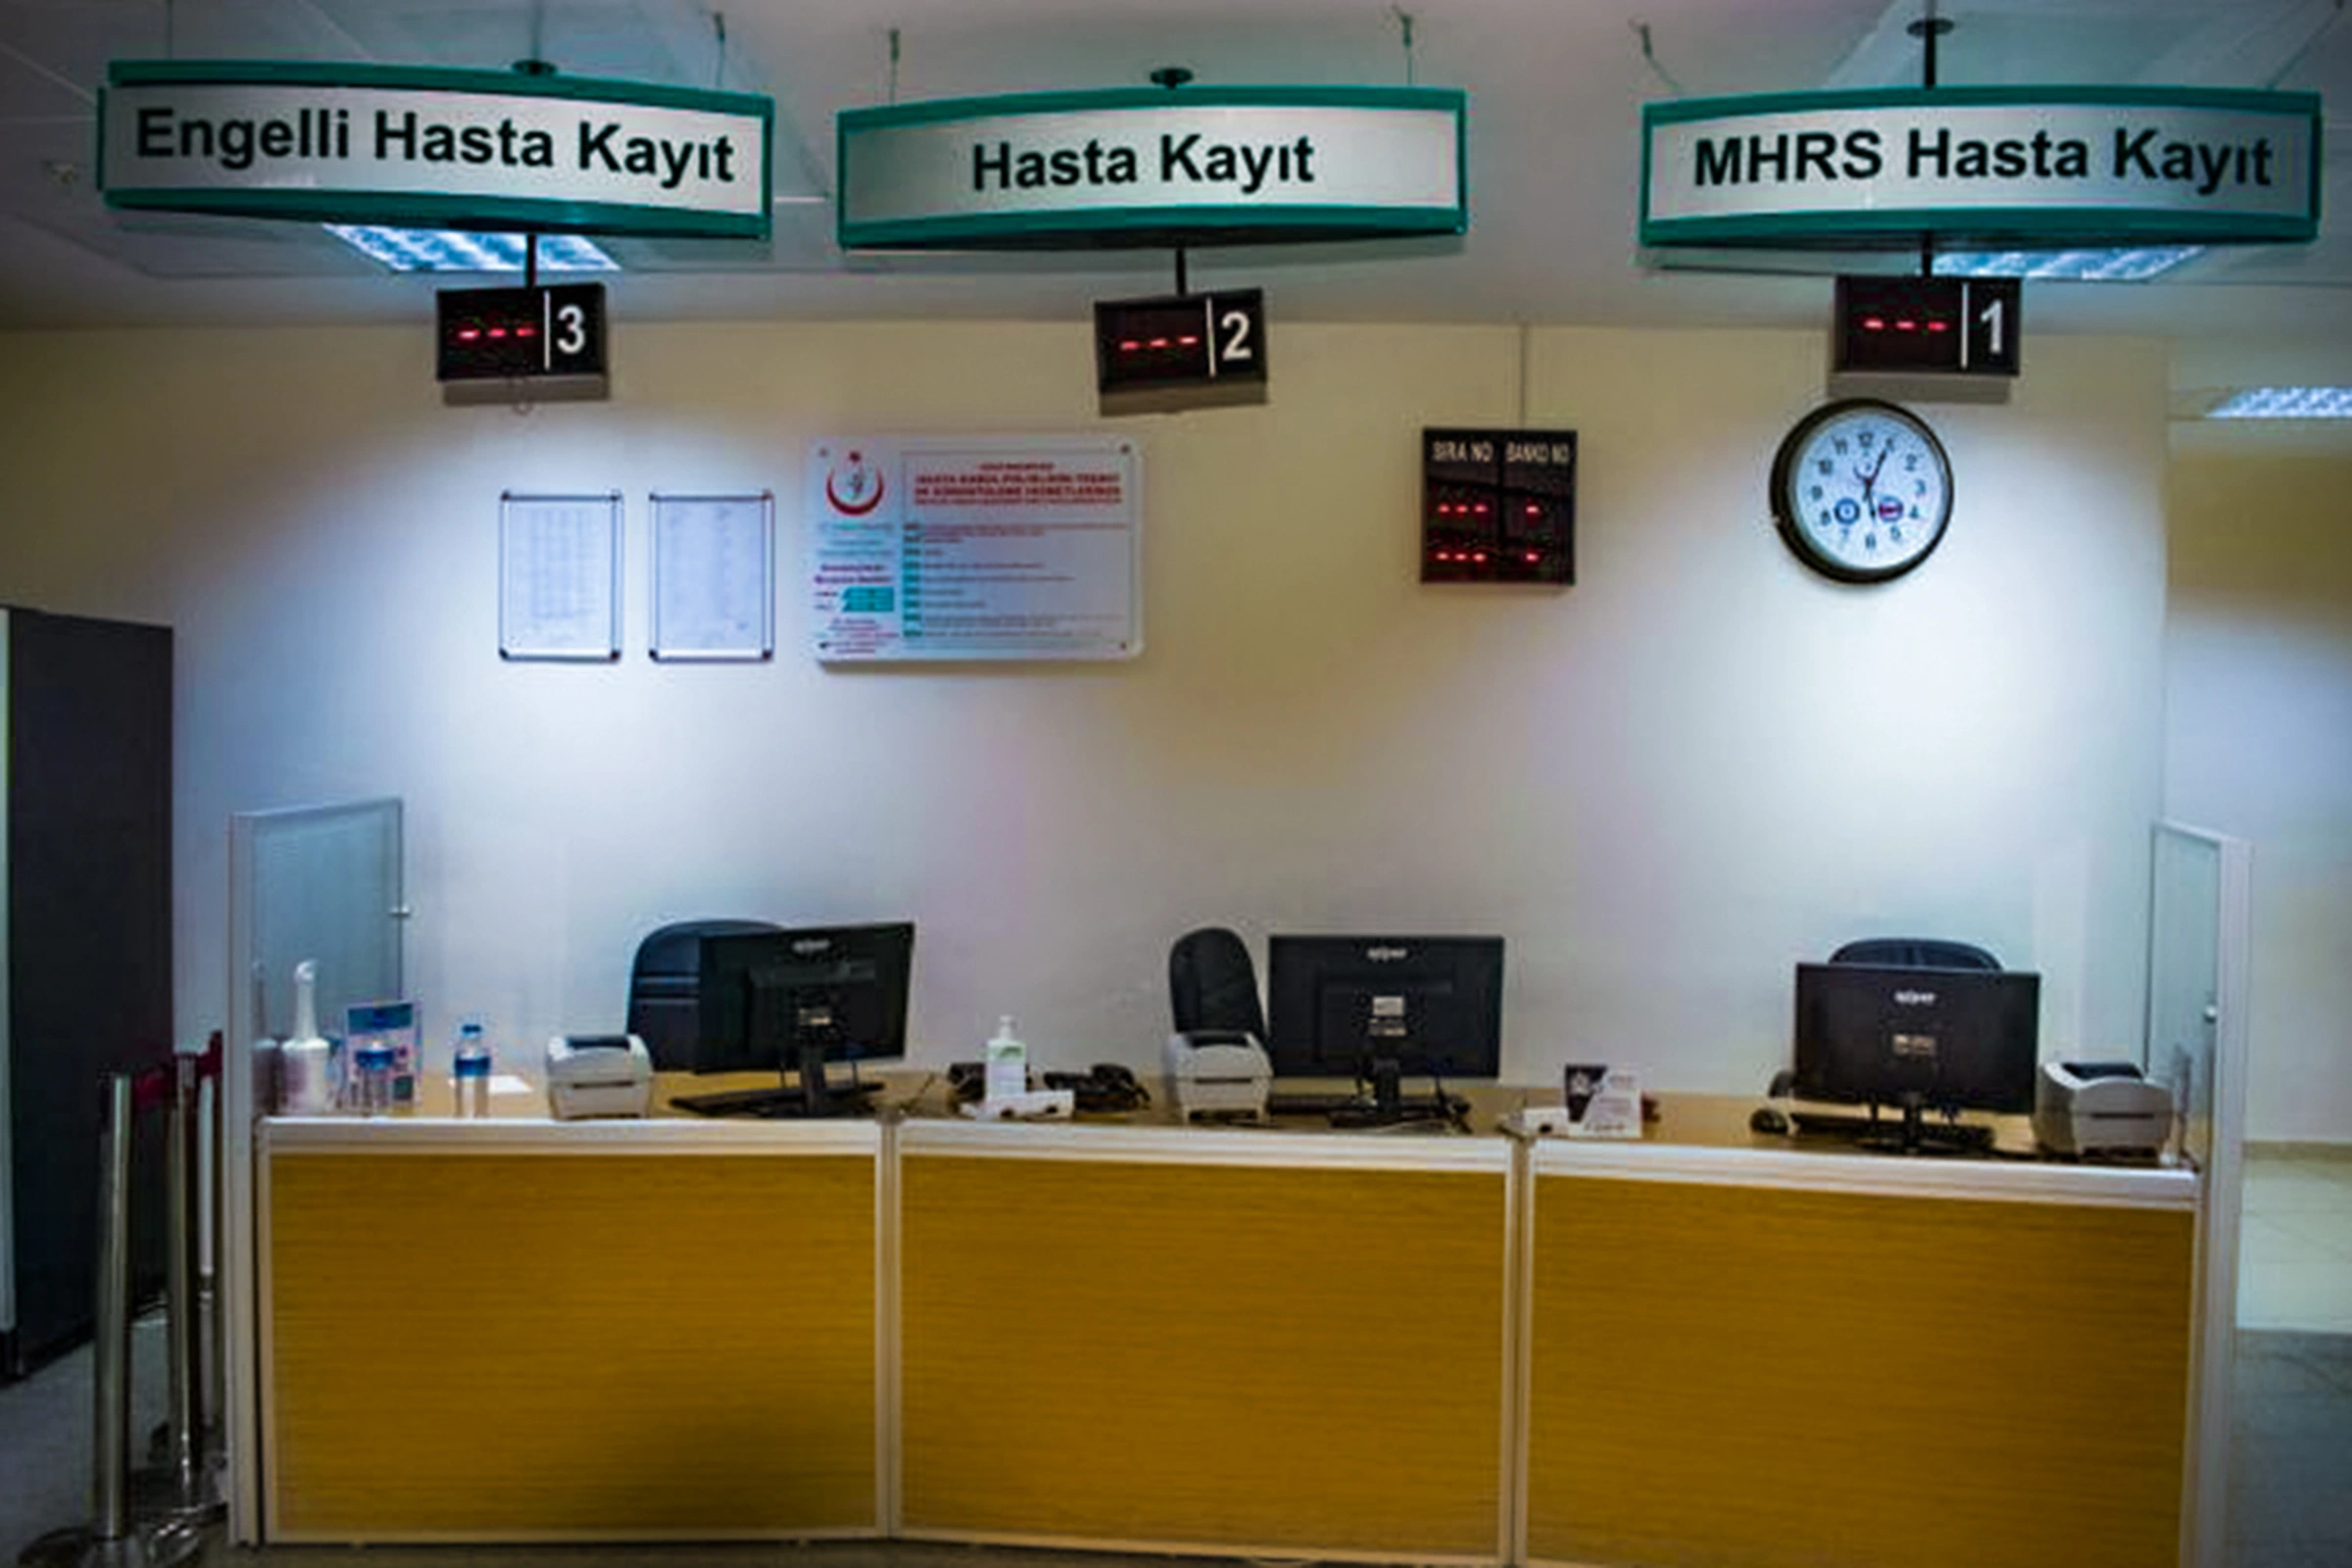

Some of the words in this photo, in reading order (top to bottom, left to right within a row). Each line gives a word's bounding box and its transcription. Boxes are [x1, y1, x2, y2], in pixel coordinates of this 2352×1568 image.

[136, 107, 349, 171] Engelli
[374, 111, 554, 168] Hasta
[579, 122, 735, 189] Kayıt
[972, 139, 1138, 193] Hasta
[1160, 133, 1315, 194] Kayıt
[1693, 129, 1883, 186] MHRS
[1907, 128, 2088, 178] Hasta
[2112, 127, 2274, 195] Kayıt
[557, 305, 586, 354] 3
[1221, 311, 1252, 360] 2
[1980, 301, 2003, 354] 1
[1471, 441, 1494, 463] NO
